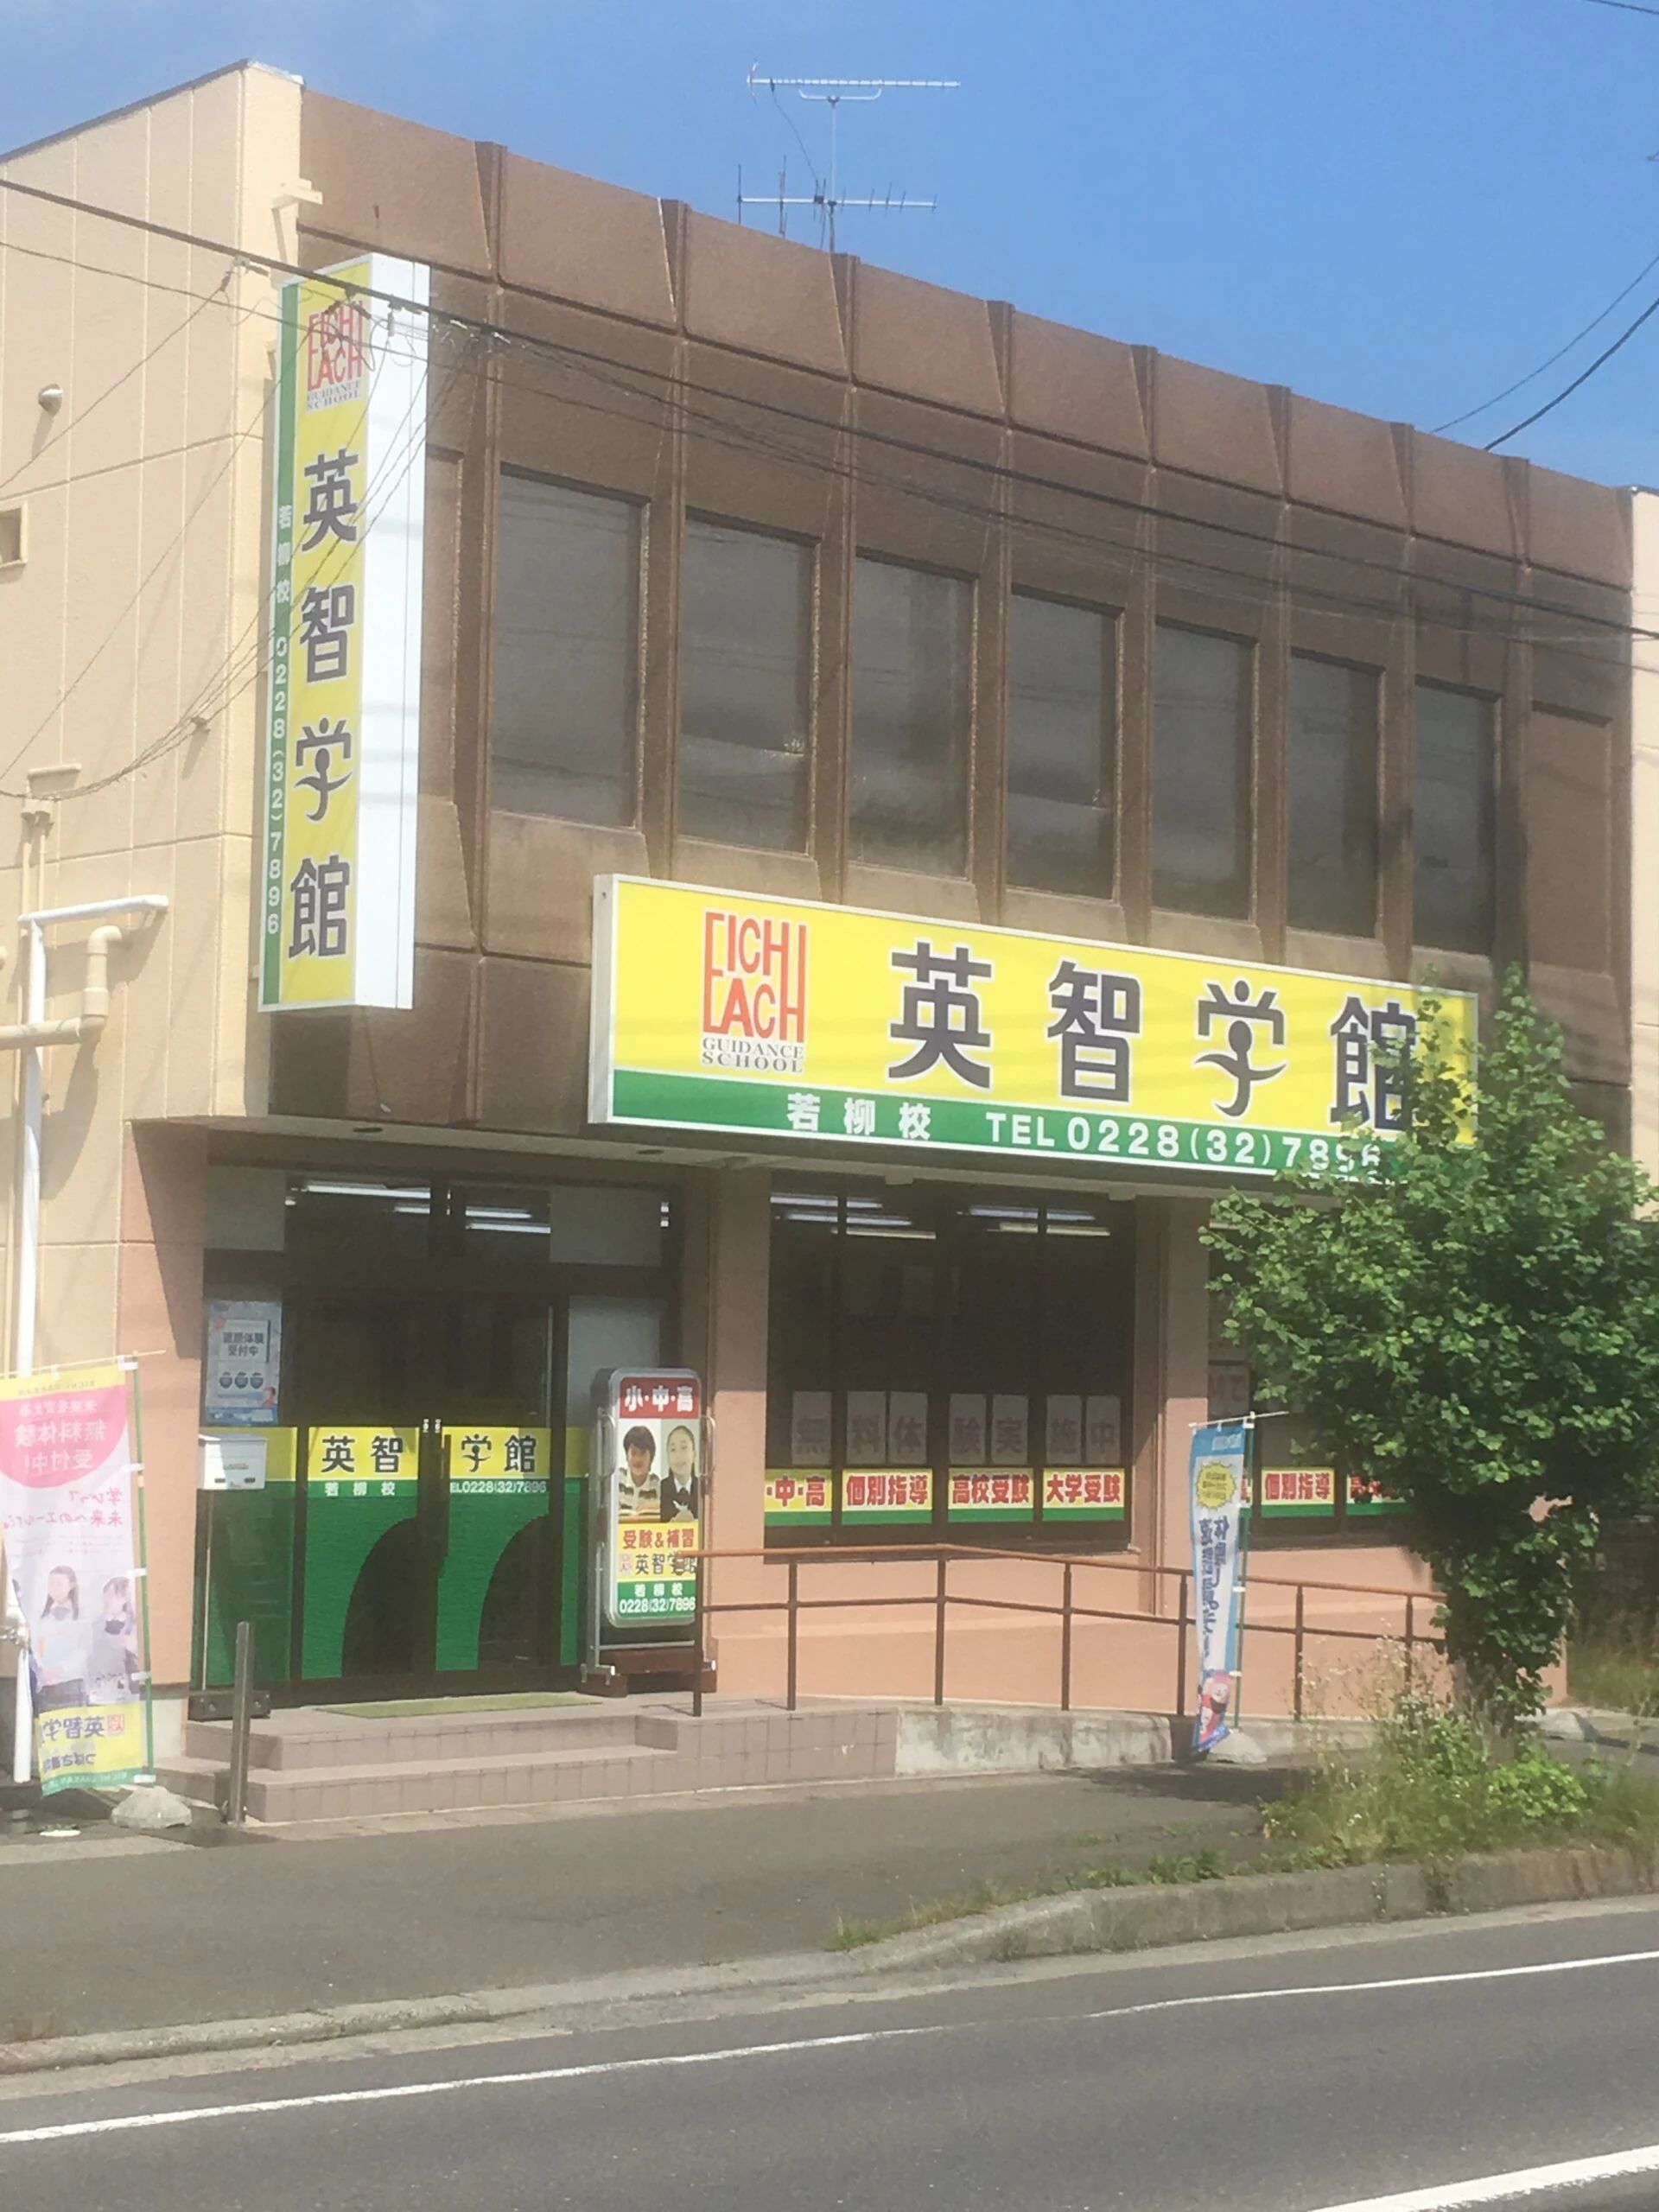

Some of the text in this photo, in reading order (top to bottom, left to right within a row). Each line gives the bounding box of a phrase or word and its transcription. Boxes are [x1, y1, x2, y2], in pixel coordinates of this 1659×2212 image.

[289, 448, 359, 959] 英智学館
[702, 1037, 804, 1060] GUIDANCE
[888, 941, 1417, 1131] 英智学館
[702, 1051, 804, 1073] SCHOOL
[787, 1093, 931, 1141] 若柳校
[846, 1473, 929, 1506] 個別指導
[951, 1473, 1030, 1505] 高校受験
[1046, 1473, 1122, 1504] 大学受験
[1264, 1473, 1331, 1502] 個別指導
